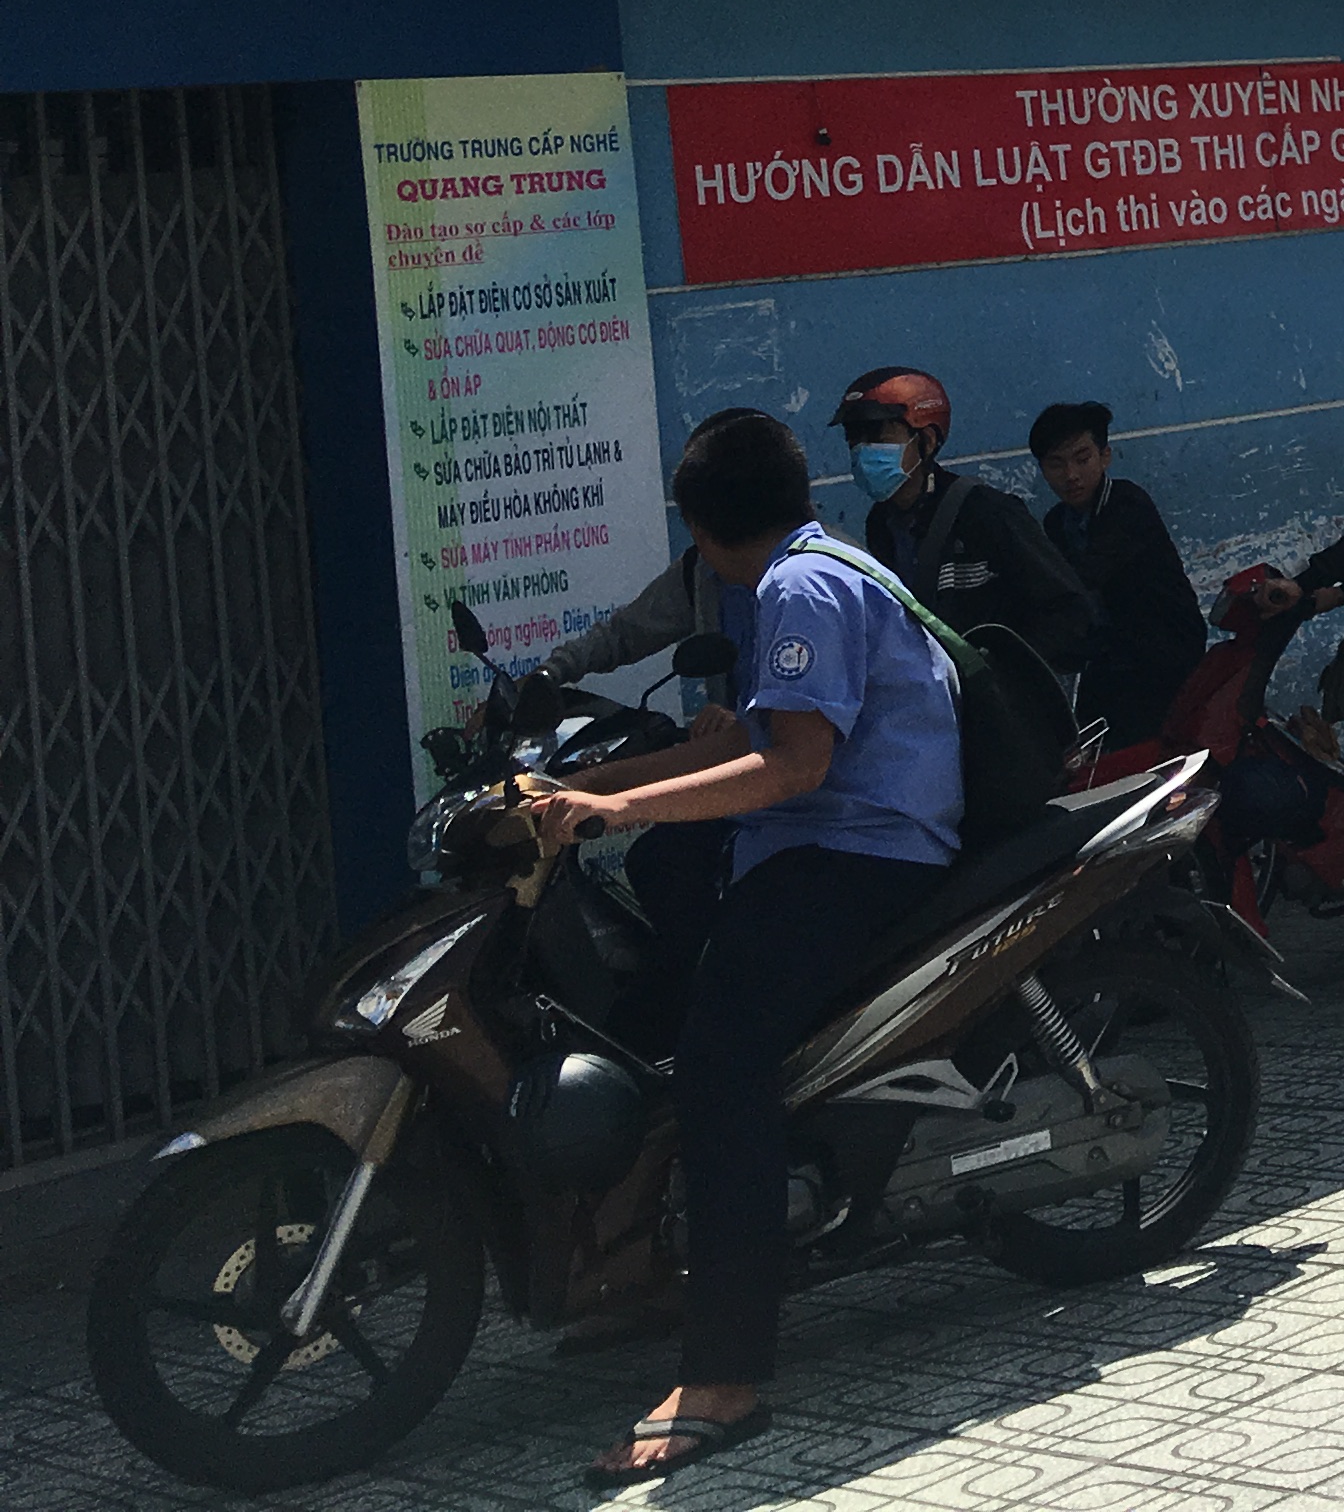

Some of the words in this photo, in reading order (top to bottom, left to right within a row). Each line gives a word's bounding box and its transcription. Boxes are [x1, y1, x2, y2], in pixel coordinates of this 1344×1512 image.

[1016, 78, 1179, 127] THƯỜNG
[1189, 72, 1299, 119] XUYÊN
[460, 136, 523, 161] TRUNG
[529, 128, 565, 157] CẤP
[695, 151, 864, 205] HƯỚNG
[877, 143, 961, 193] DẪN
[975, 140, 1071, 192] LUẬT
[1085, 138, 1182, 178] GTĐB
[1190, 134, 1245, 171] THI
[1256, 124, 1320, 168] CẤP
[397, 175, 504, 204] QUANG
[510, 169, 607, 195] TRUNG
[386, 222, 423, 241] Đào
[431, 223, 460, 242] tạo
[466, 222, 485, 236] sơ
[492, 211, 523, 237] cấp
[530, 215, 545, 231] &
[552, 212, 581, 229] các
[587, 210, 616, 231] lớp
[1022, 198, 1106, 250] (Lịch
[1118, 196, 1160, 231] thi
[1169, 189, 1227, 227] vào
[1238, 185, 1293, 222] các
[388, 246, 456, 270] chuyên
[462, 239, 485, 263] đề
[479, 281, 510, 318] ĐIỆN
[513, 282, 532, 311] CƠ
[585, 269, 617, 303] XUẤT
[578, 320, 597, 345] CƠ
[428, 378, 437, 400] &
[493, 404, 524, 441] ĐIỆN
[528, 400, 552, 437] NỘI
[554, 393, 587, 430] THẤT
[465, 450, 502, 482] CHỮA
[504, 444, 532, 477] BẢO
[577, 440, 611, 471] LẠNH
[614, 439, 623, 462] &
[438, 498, 466, 529] MÁY
[504, 488, 531, 520] HÒA
[534, 484, 579, 515] KHÔNG
[583, 478, 604, 506] KHÍ
[471, 537, 498, 565] MÁY
[493, 574, 520, 603] VĂN
[523, 567, 569, 599] PHÒNG
[487, 623, 512, 650] ông
[946, 890, 1065, 976] FUTURE
[408, 1027, 461, 1049] HONDA
